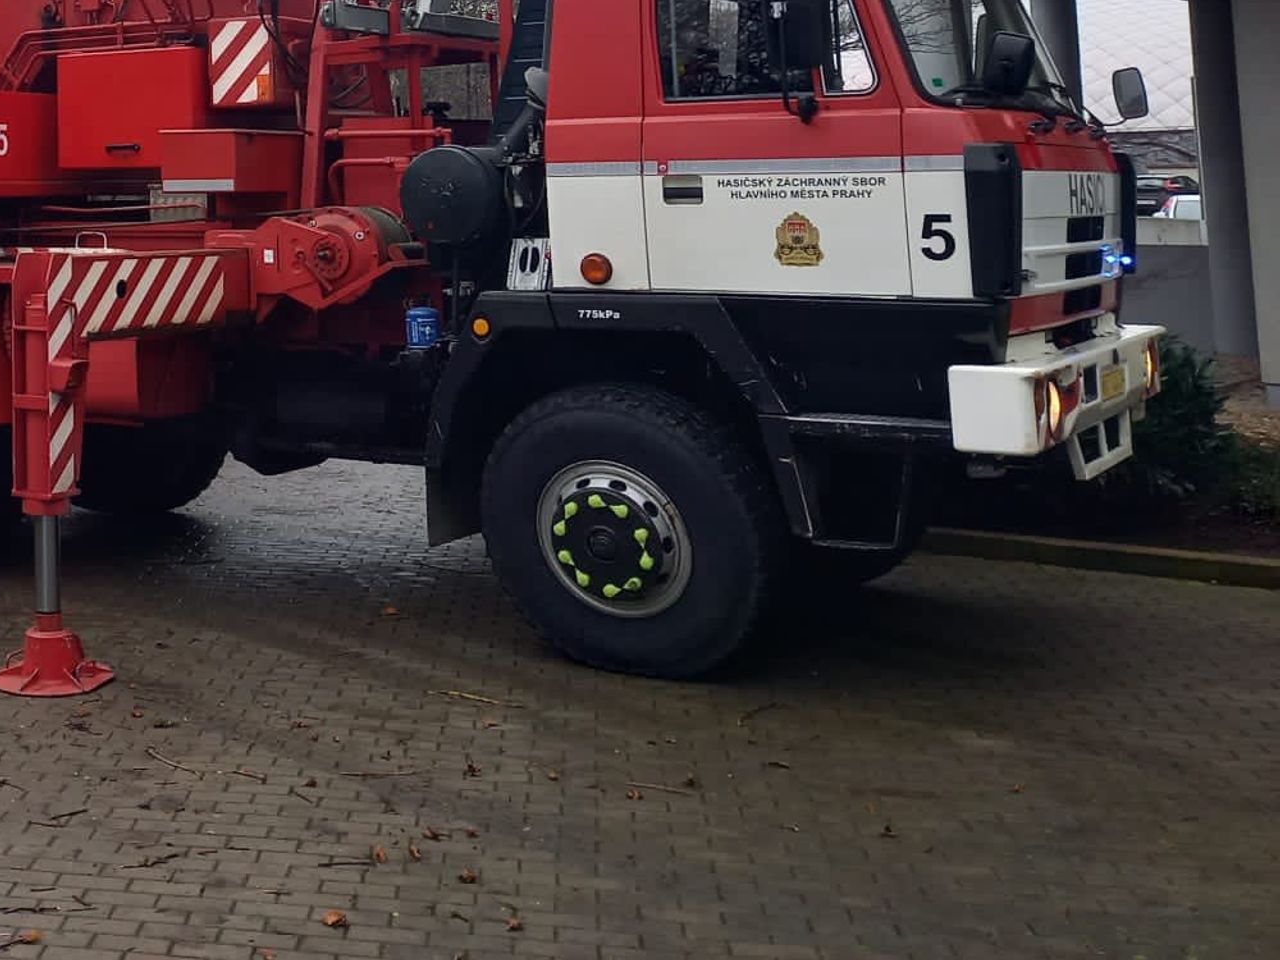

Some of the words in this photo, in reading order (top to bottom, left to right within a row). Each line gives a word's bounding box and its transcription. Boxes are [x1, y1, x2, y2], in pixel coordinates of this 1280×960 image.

[717, 177, 772, 188] HASIČSKÝ
[776, 176, 848, 187] ZÁCHRANNÝ
[852, 176, 886, 187] SBOR
[730, 189, 787, 200] HLAVNÍHO
[790, 188, 830, 199] MĚSTA
[832, 189, 873, 199] PRAHY
[921, 213, 956, 261] 5
[578, 309, 620, 319] 775kPa
